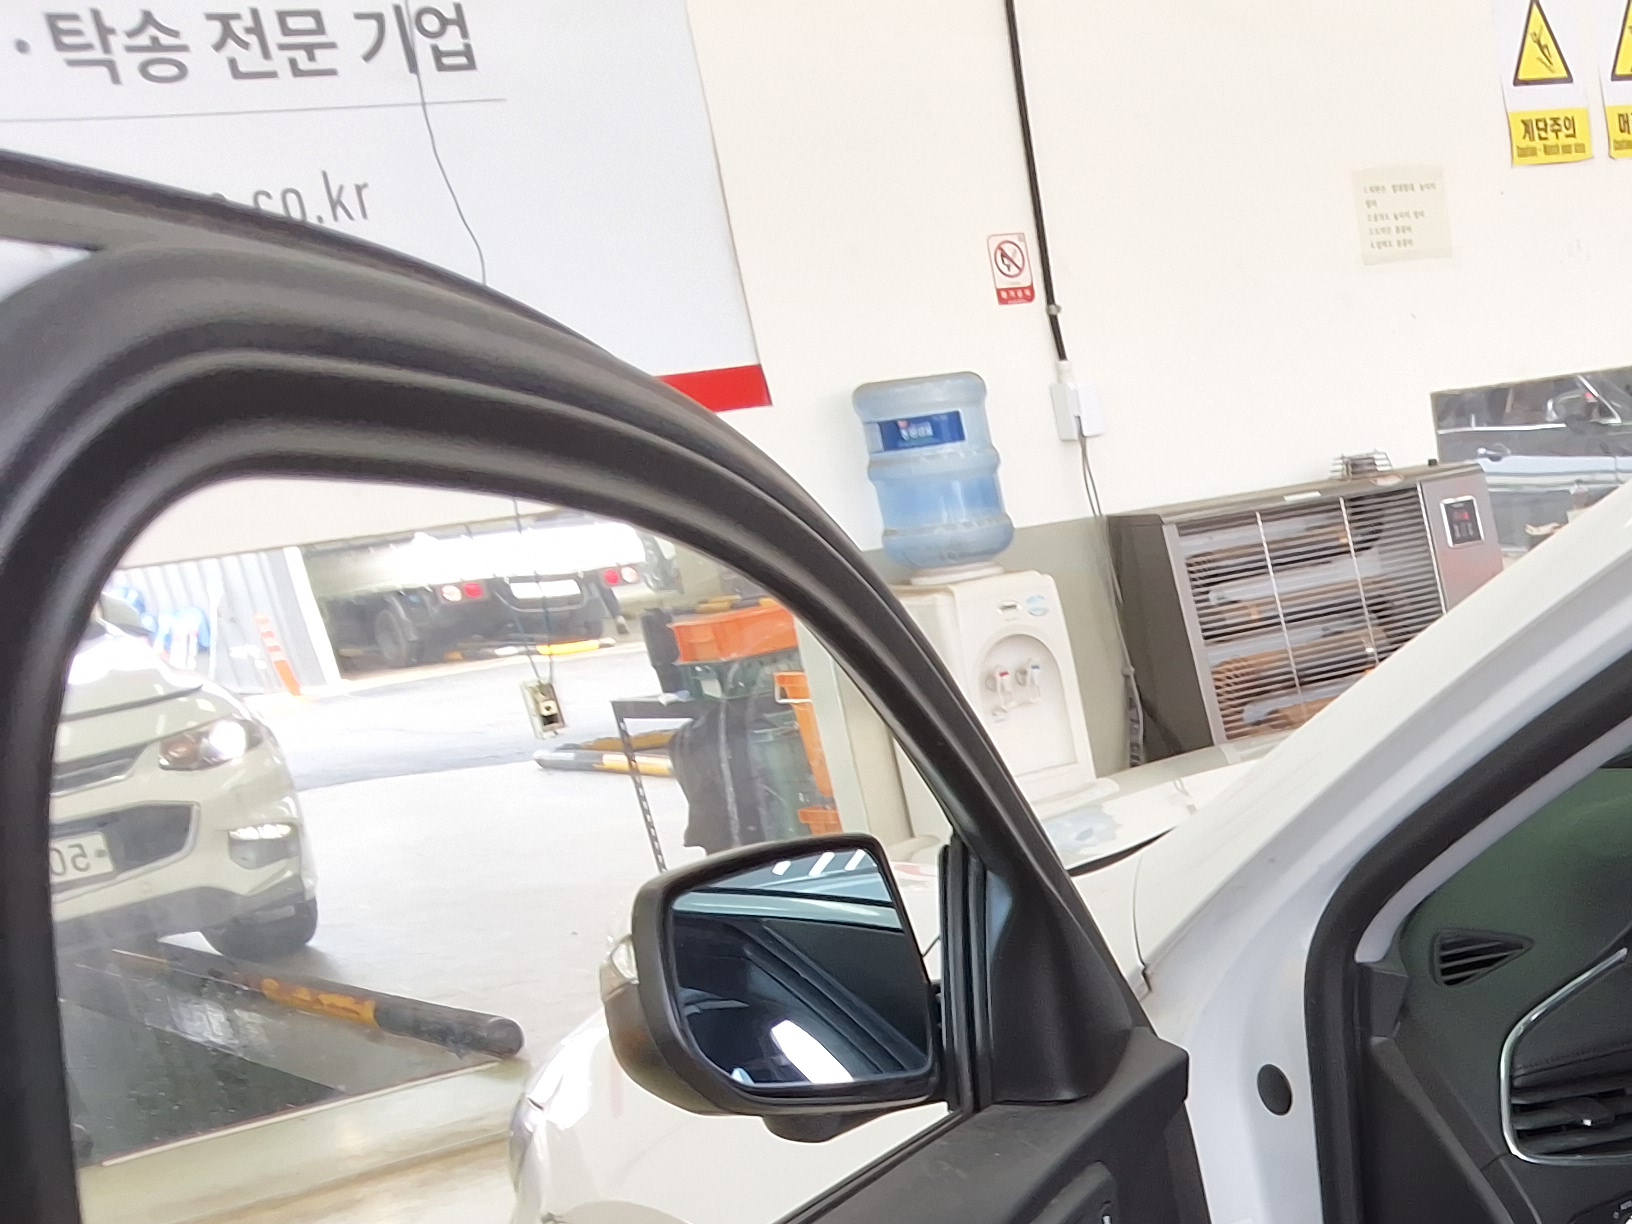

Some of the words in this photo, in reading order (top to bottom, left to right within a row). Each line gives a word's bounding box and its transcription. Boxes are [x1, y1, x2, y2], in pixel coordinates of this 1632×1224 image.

[43, 8, 190, 85] 탁송
[204, 7, 338, 80] 전문
[353, 2, 478, 75] 기업
[1520, 115, 1577, 142] 계단주의
